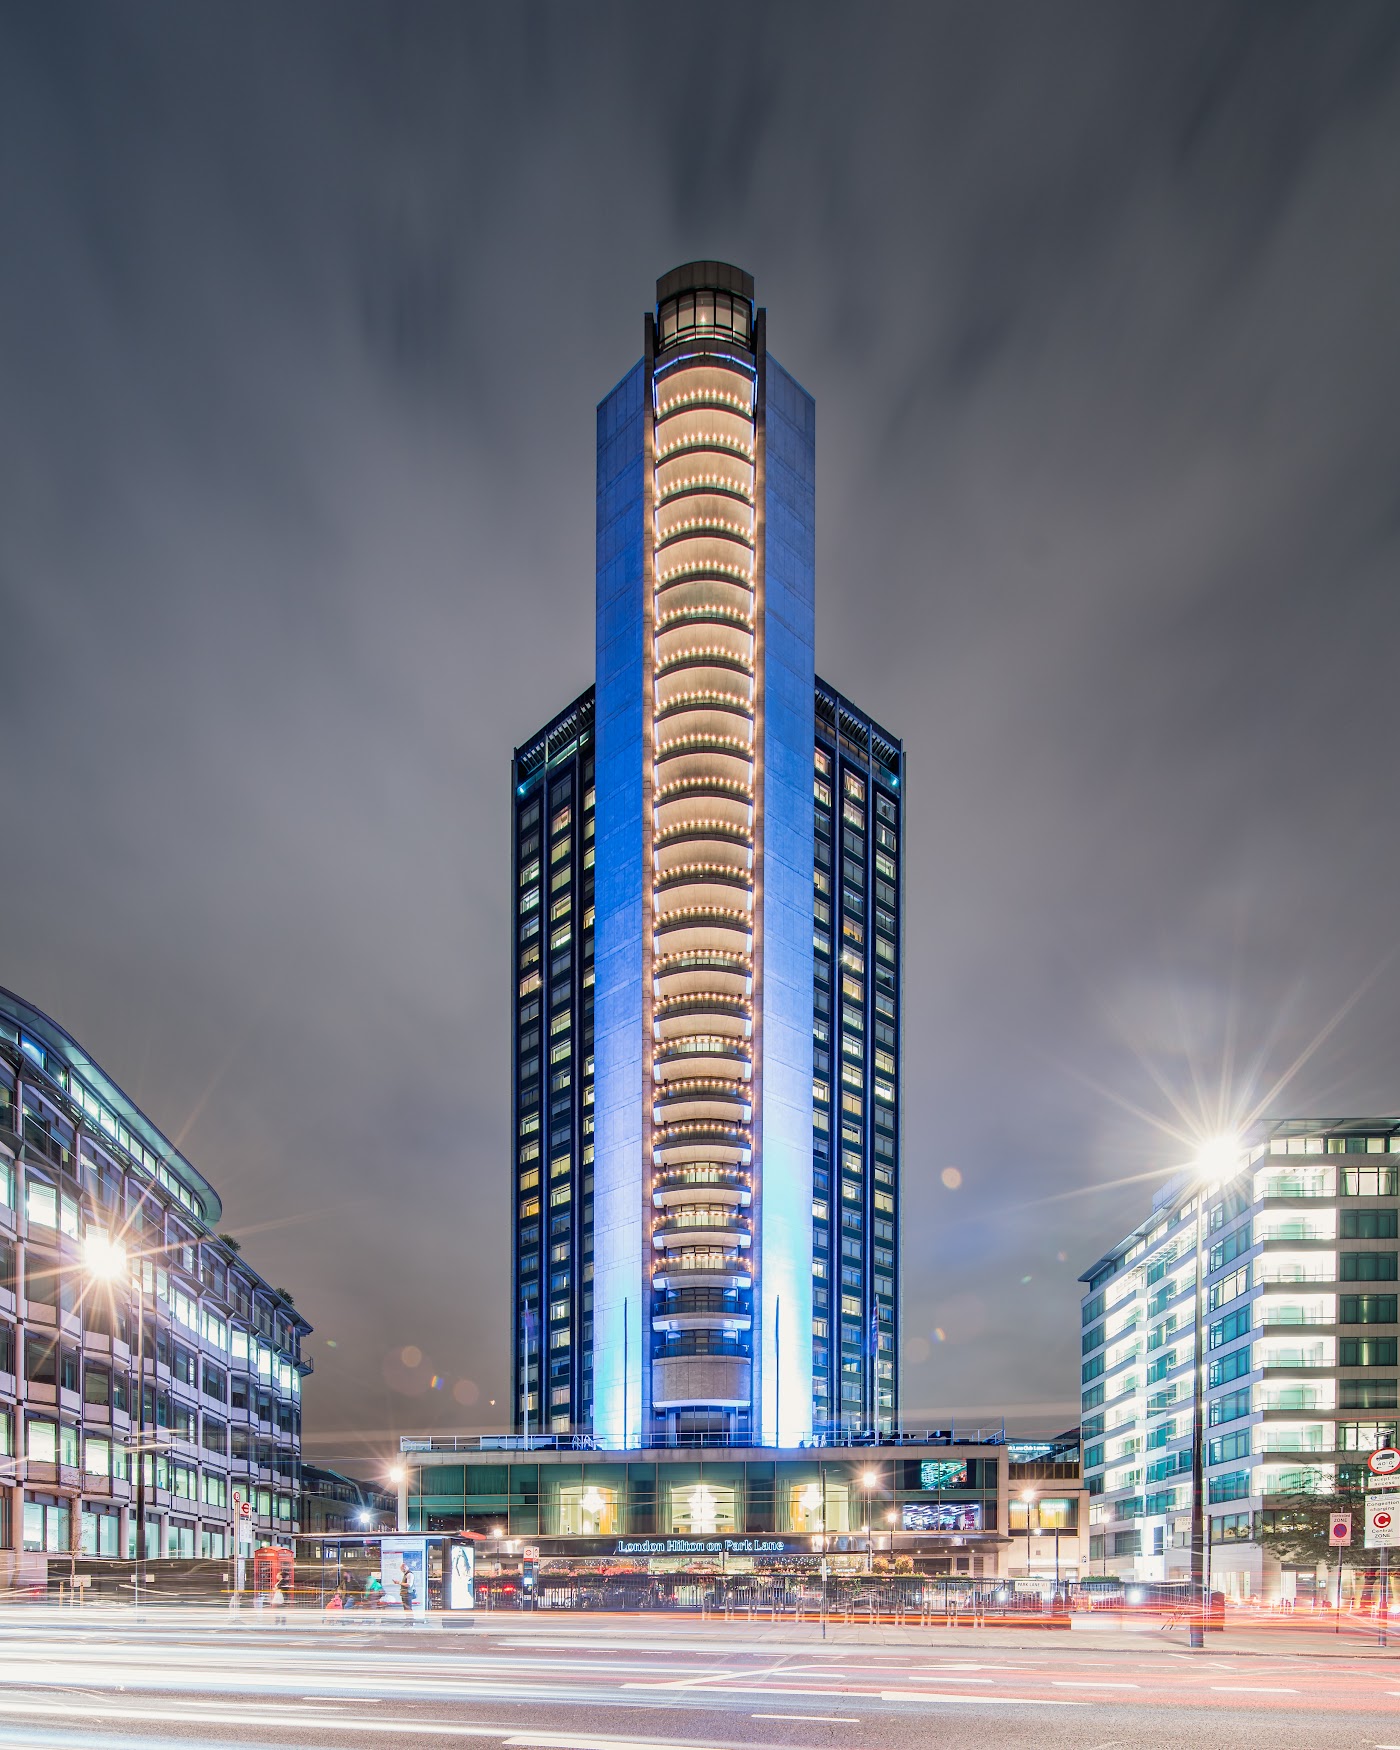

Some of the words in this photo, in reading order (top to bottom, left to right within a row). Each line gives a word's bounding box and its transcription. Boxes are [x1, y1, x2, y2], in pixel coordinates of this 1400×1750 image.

[618, 1540, 664, 1552] London
[667, 1540, 705, 1552] Hilton
[706, 1542, 722, 1551] on
[725, 1540, 752, 1551] Park
[754, 1539, 784, 1551] Lane
